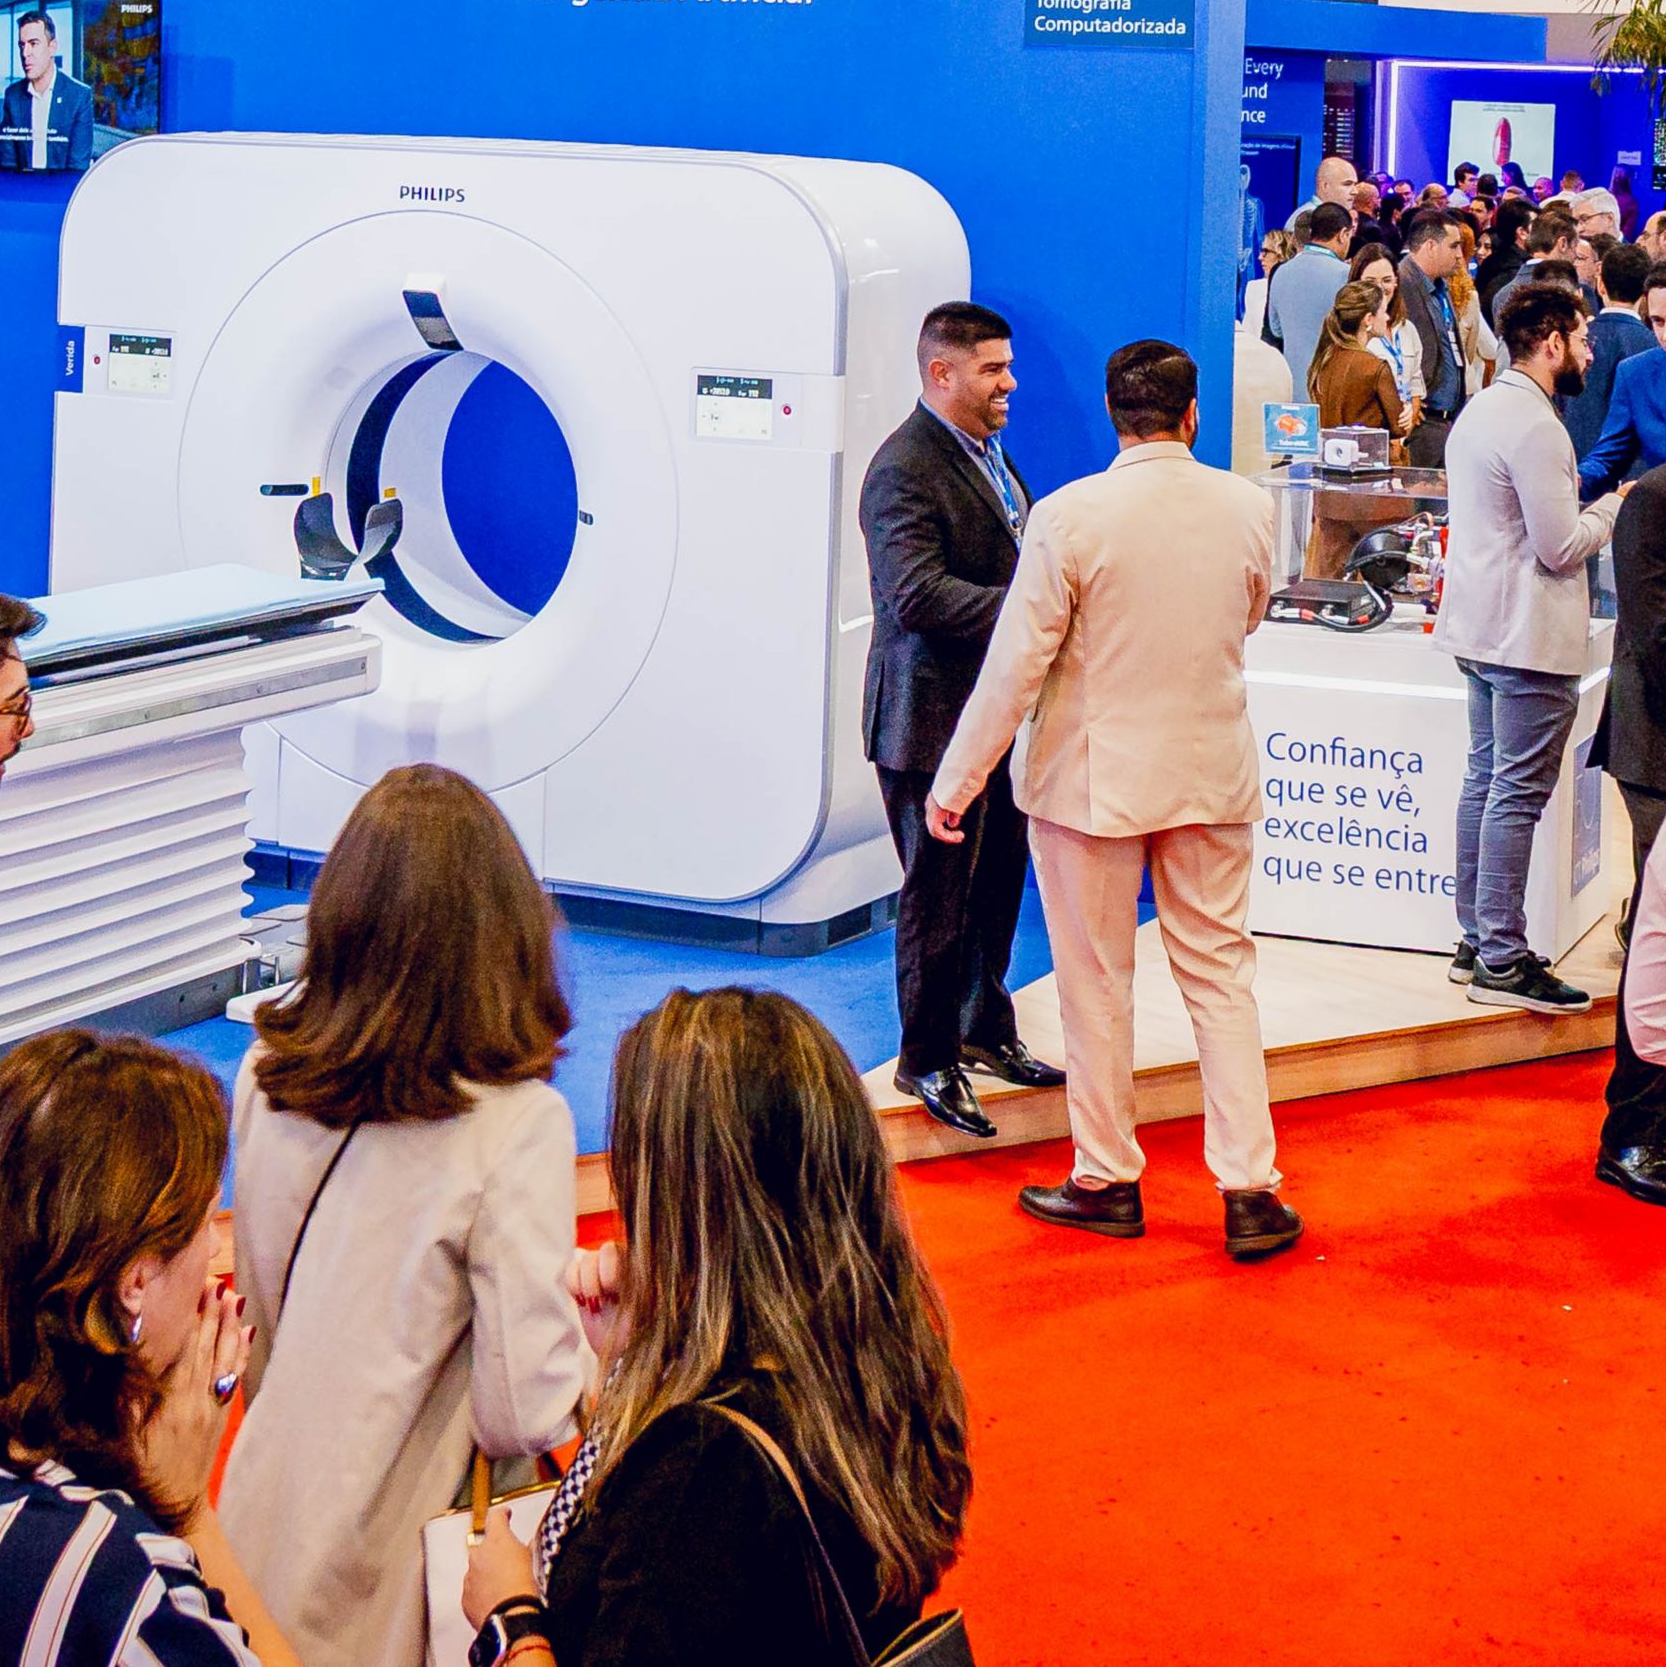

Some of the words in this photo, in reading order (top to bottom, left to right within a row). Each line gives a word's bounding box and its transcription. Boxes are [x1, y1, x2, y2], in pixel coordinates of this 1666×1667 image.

[1034, 15, 1187, 36] Computadorizada
[1245, 58, 1283, 80] Every
[400, 186, 465, 202] PHILIPS
[66, 340, 75, 376] Verida
[1267, 732, 1423, 778] Confiança
[1266, 779, 1325, 807] que
[1335, 786, 1367, 808] se
[1377, 784, 1421, 818] vê,
[1264, 817, 1428, 853] excelência
[1263, 856, 1323, 884] que
[1333, 865, 1365, 886] se
